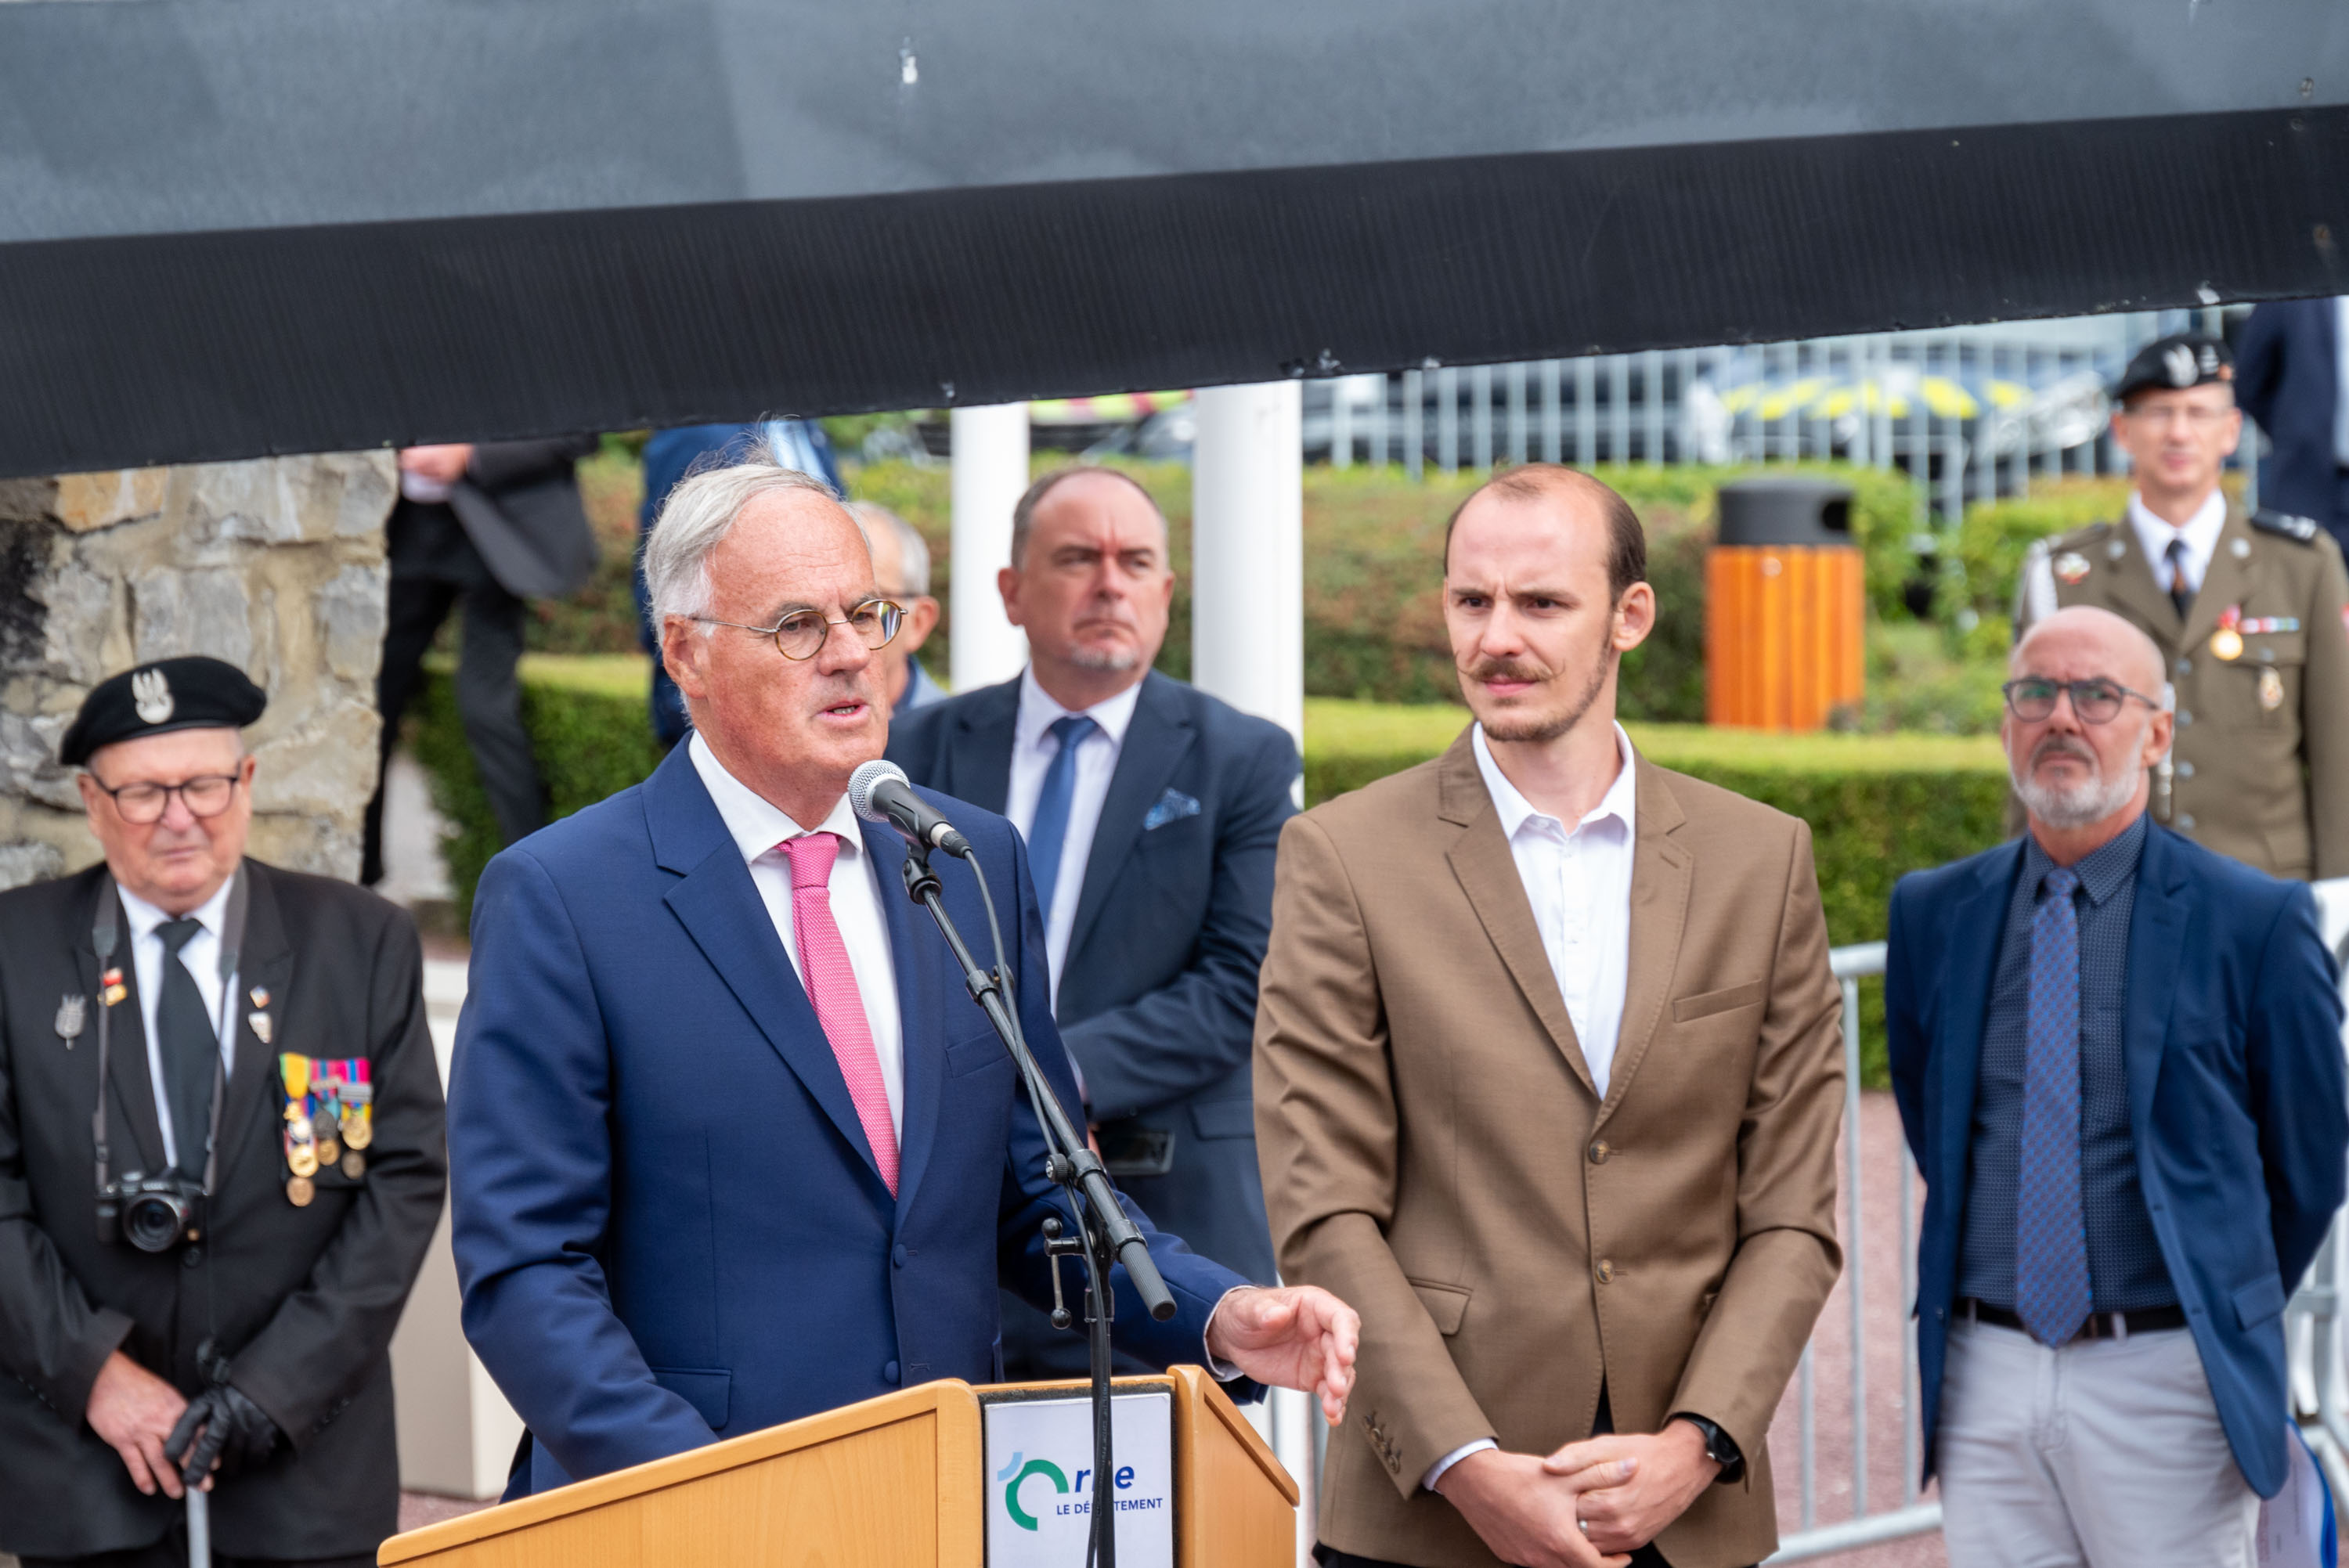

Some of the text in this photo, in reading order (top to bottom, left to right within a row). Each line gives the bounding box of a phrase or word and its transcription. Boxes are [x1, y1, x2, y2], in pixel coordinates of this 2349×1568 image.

[1005, 1459, 1135, 1531] Ore
[1057, 1498, 1163, 1515] LE DÉTEMENT
